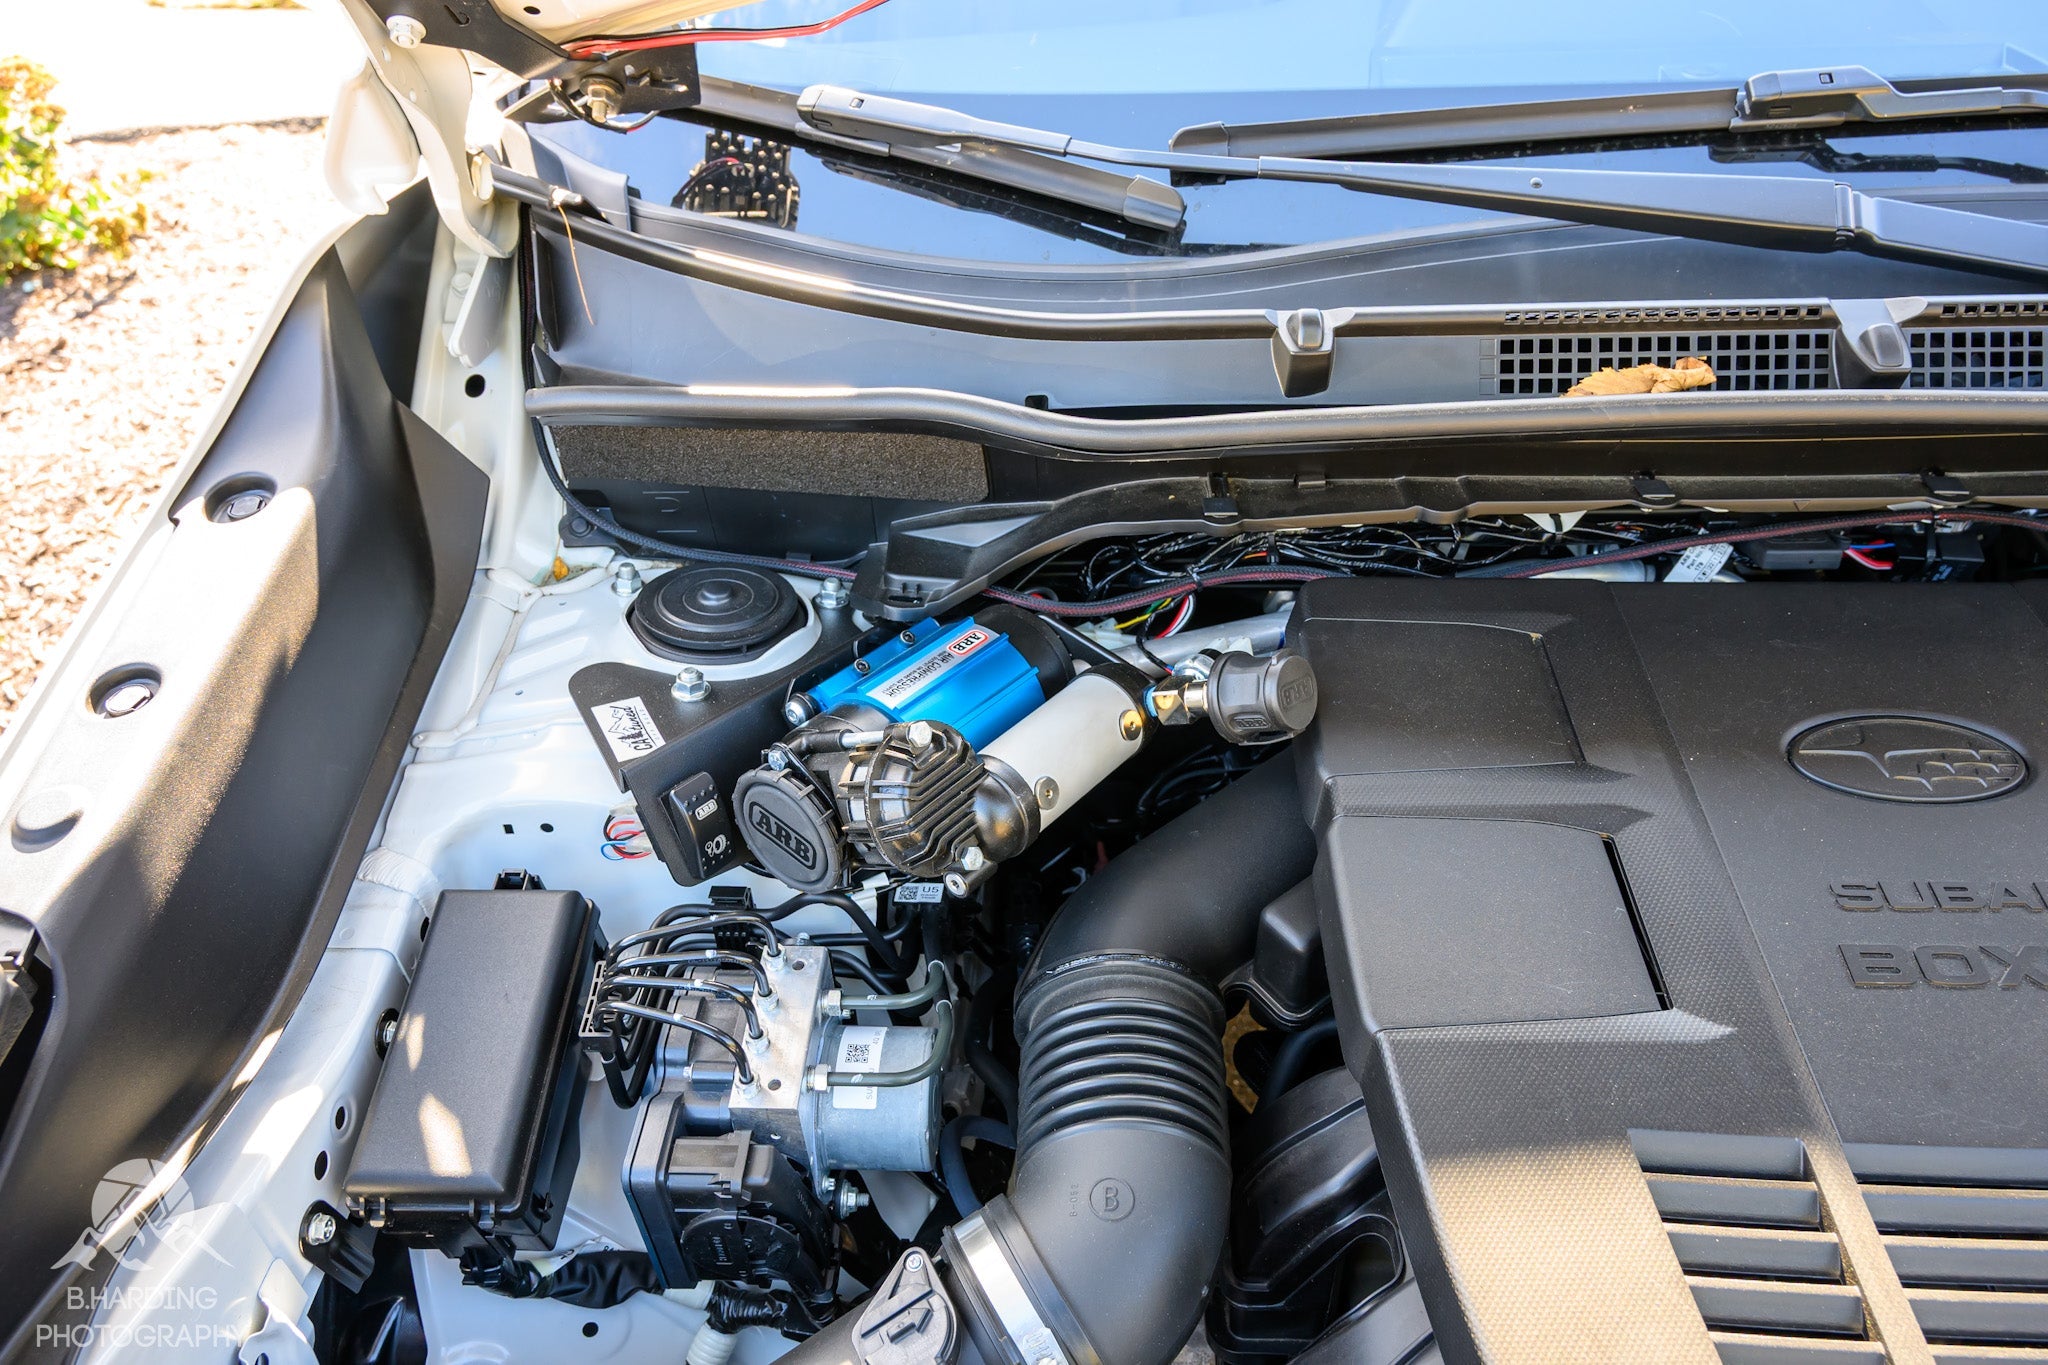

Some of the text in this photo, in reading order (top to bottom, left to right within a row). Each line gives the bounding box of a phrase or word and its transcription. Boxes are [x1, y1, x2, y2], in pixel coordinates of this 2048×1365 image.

[888, 632, 982, 697] ARB AIR COMPRESSOR
[696, 803, 717, 818] ARB
[755, 810, 812, 863] ARB
[1829, 881, 2048, 911] SUBA
